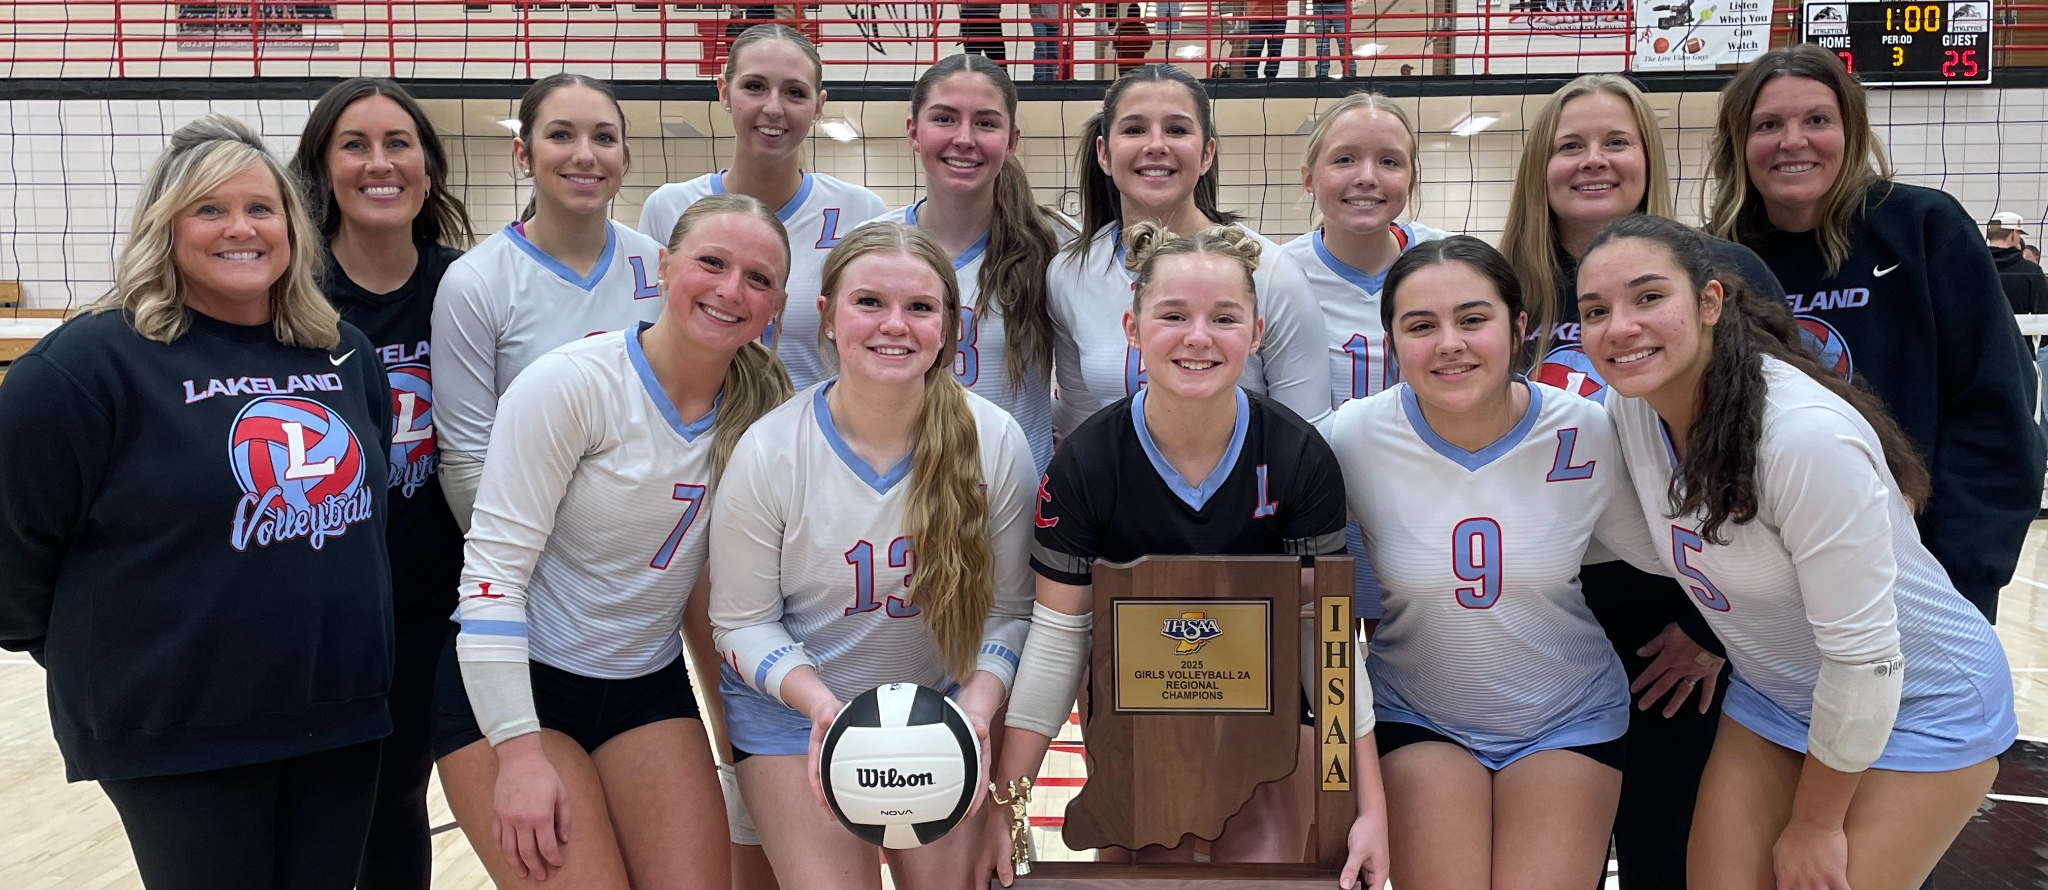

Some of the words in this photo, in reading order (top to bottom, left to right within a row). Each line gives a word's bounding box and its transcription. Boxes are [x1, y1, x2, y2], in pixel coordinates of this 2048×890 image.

[1729, 2, 1758, 10] Listen
[1719, 15, 1746, 24] When
[1749, 14, 1768, 22] You
[1886, 5, 1941, 33] 1:00
[1733, 28, 1753, 37] Can
[1818, 36, 1851, 48] HOME
[1881, 35, 1913, 45] PEROD
[1942, 34, 1979, 46] GUEST
[1727, 41, 1758, 51] Watch
[1892, 46, 1904, 67] 3
[1673, 54, 1691, 62] Video
[1692, 54, 1709, 62] Guys
[1942, 49, 1978, 77] 25
[628, 255, 662, 300] L
[182, 372, 343, 405] LAKELAND
[391, 391, 435, 444] L
[280, 421, 337, 481] L
[1544, 427, 1595, 482] L
[1252, 463, 1279, 519] L
[229, 485, 373, 553] Volleyball
[649, 482, 707, 570] 7
[1451, 516, 1501, 609] 9
[1671, 523, 1732, 613] 5
[843, 535, 922, 619] 13
[1163, 618, 1220, 639] IHSAA
[1134, 670, 1165, 680] GIRLS
[1168, 670, 1235, 680] VOLLEYBALL
[1237, 670, 1251, 680] 2A
[1180, 660, 1204, 670] 2025
[1161, 691, 1224, 700] CHAMPIONS
[1165, 681, 1220, 690] REGIONAL
[1322, 603, 1350, 785] IHSAA
[855, 767, 934, 789] Wilson
